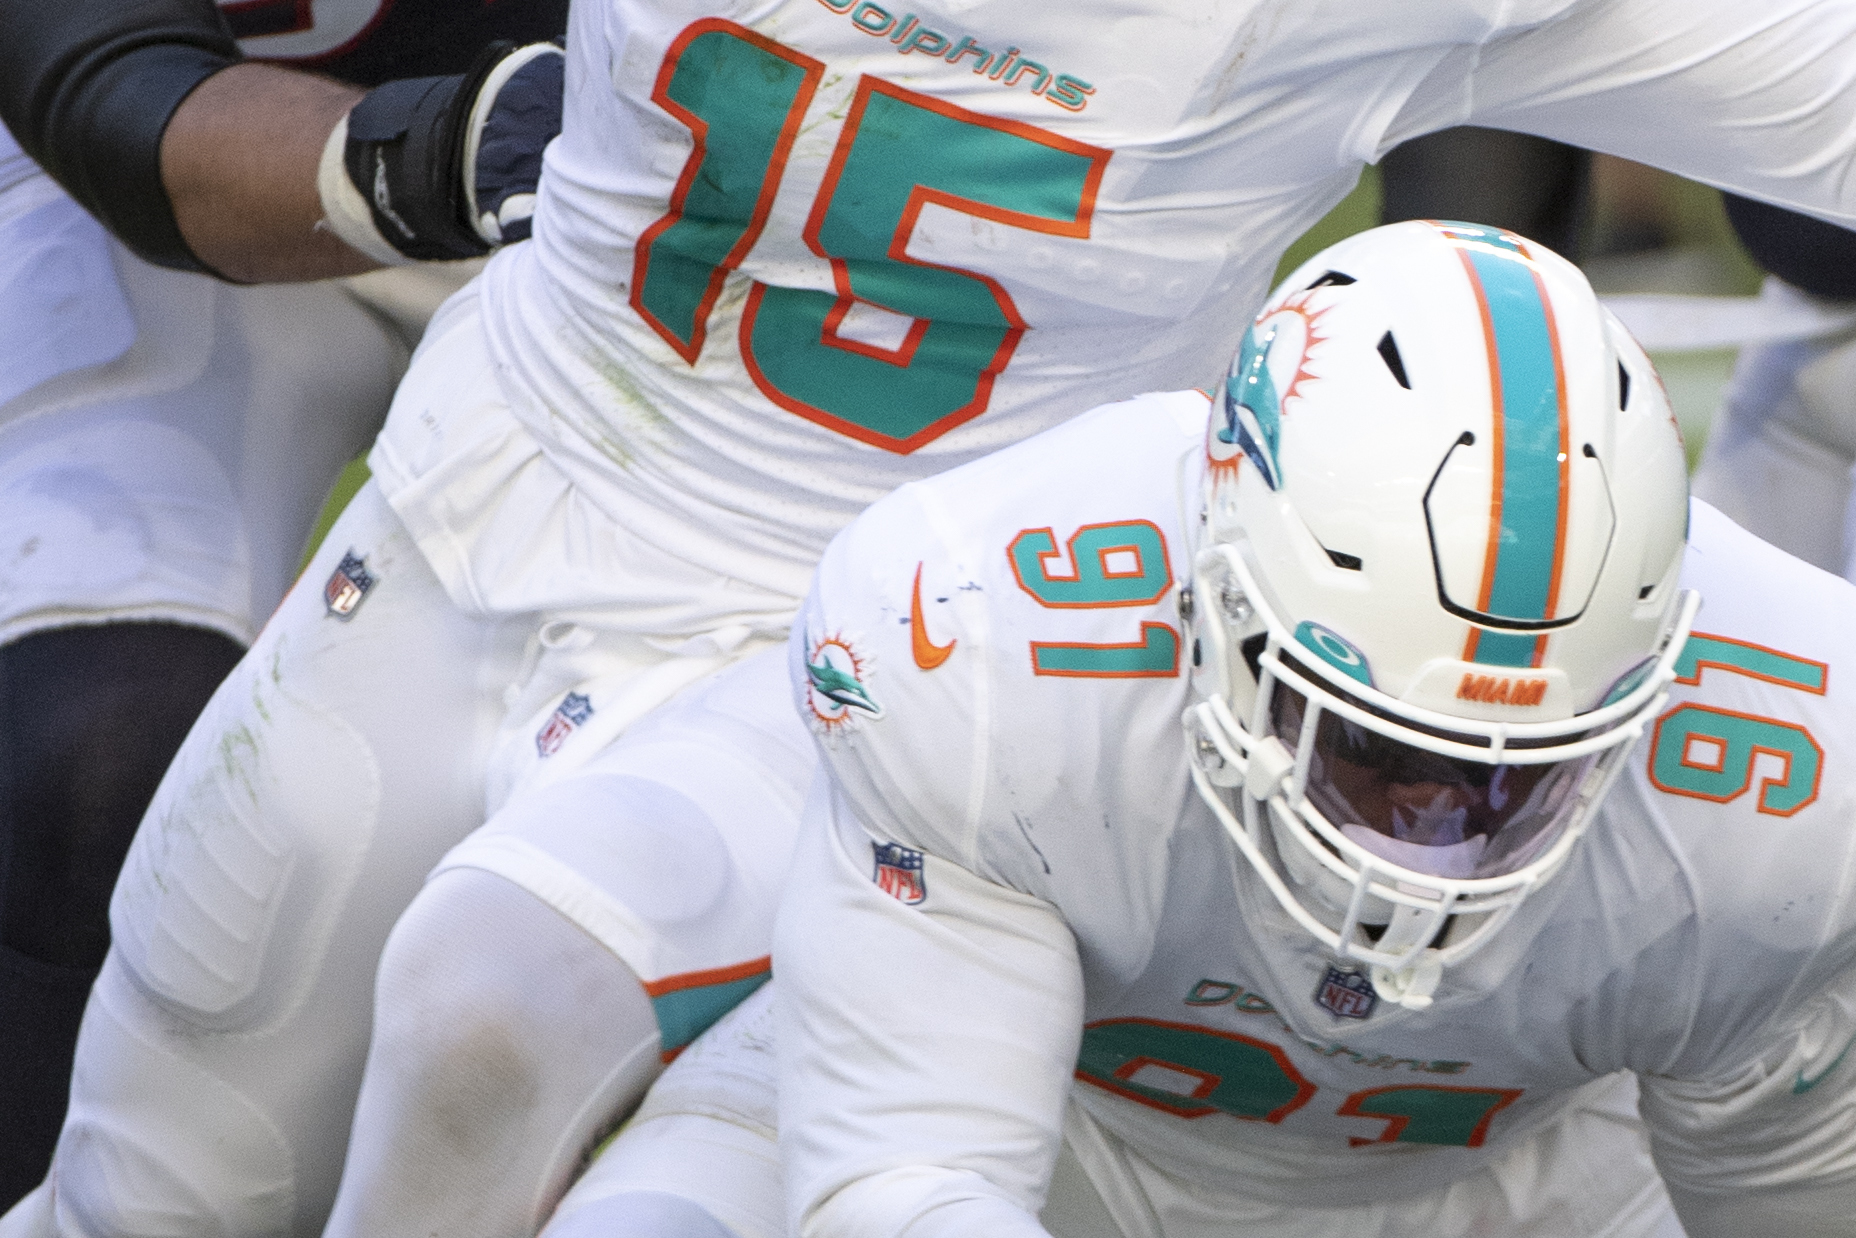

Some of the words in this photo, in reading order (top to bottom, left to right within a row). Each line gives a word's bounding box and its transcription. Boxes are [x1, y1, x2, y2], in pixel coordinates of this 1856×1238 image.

[816, 0, 1097, 112] olphins
[629, 16, 1114, 456] 15
[1005, 518, 1181, 678] 91
[1648, 631, 1830, 818] 91
[1325, 984, 1366, 1016] NFL
